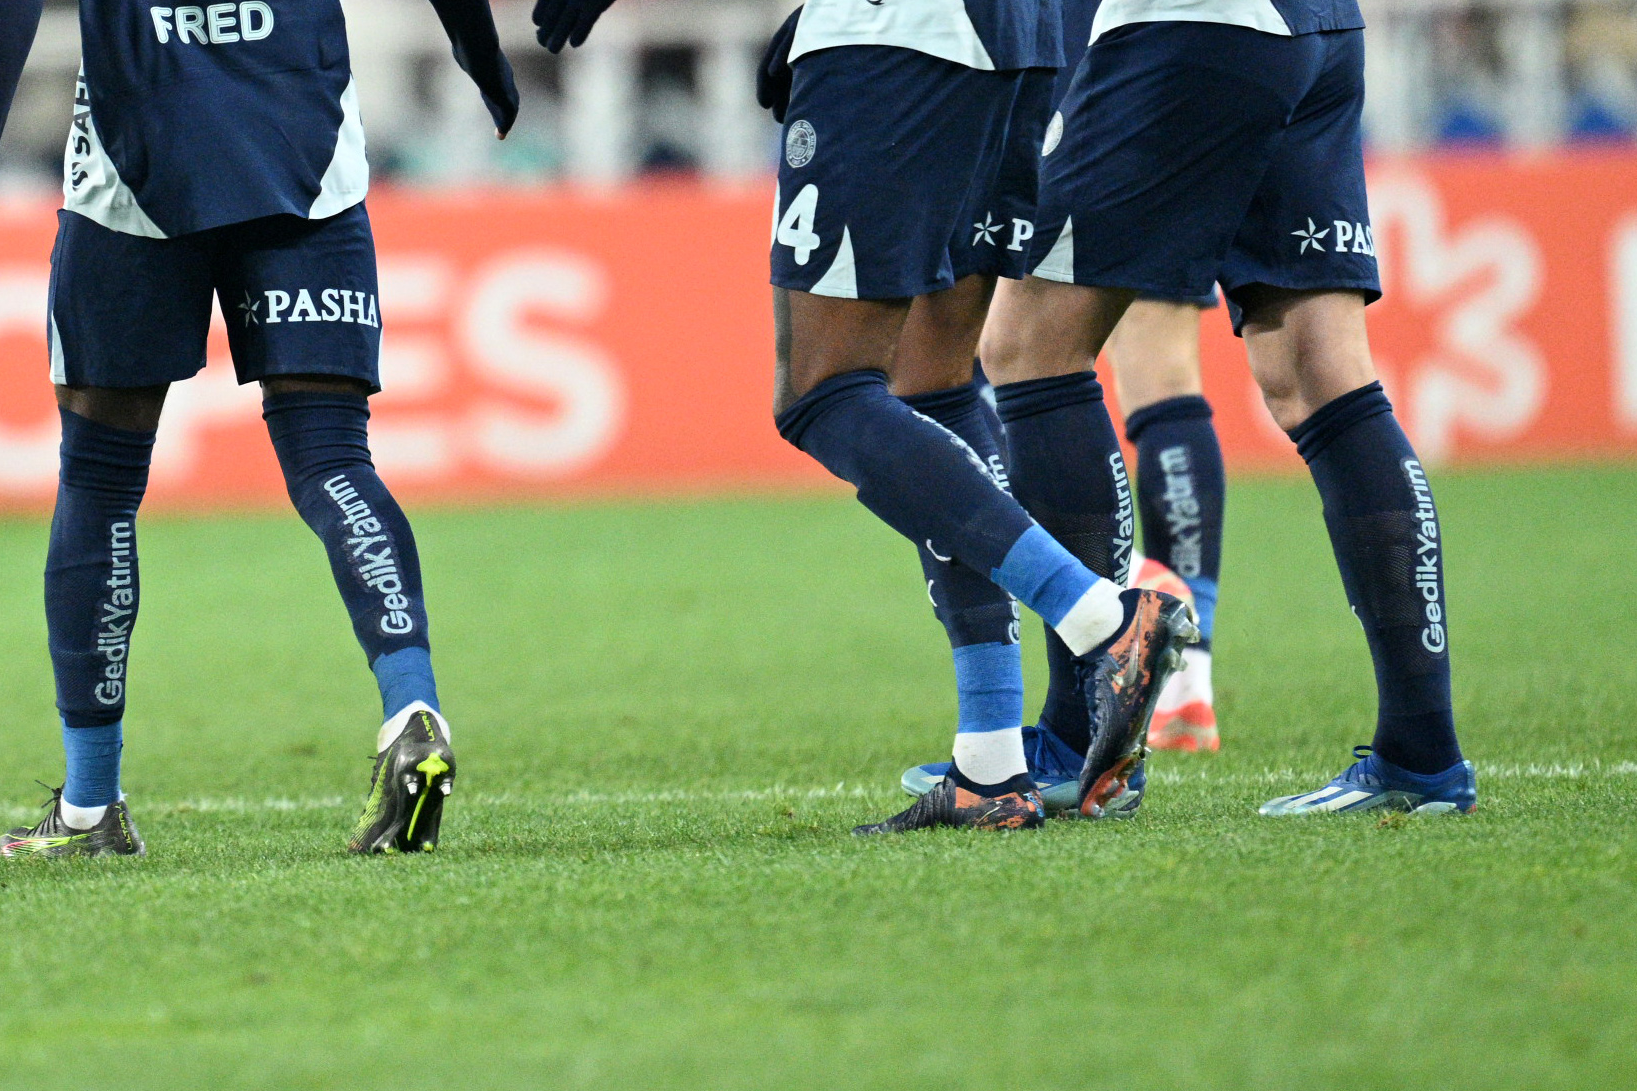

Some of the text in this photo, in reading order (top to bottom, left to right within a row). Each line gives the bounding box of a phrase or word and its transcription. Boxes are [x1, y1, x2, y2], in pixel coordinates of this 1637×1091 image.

[150, 1, 275, 45] FRED
[771, 178, 821, 266] 4
[1333, 219, 1375, 257] PAS
[263, 288, 379, 328] PASHA
